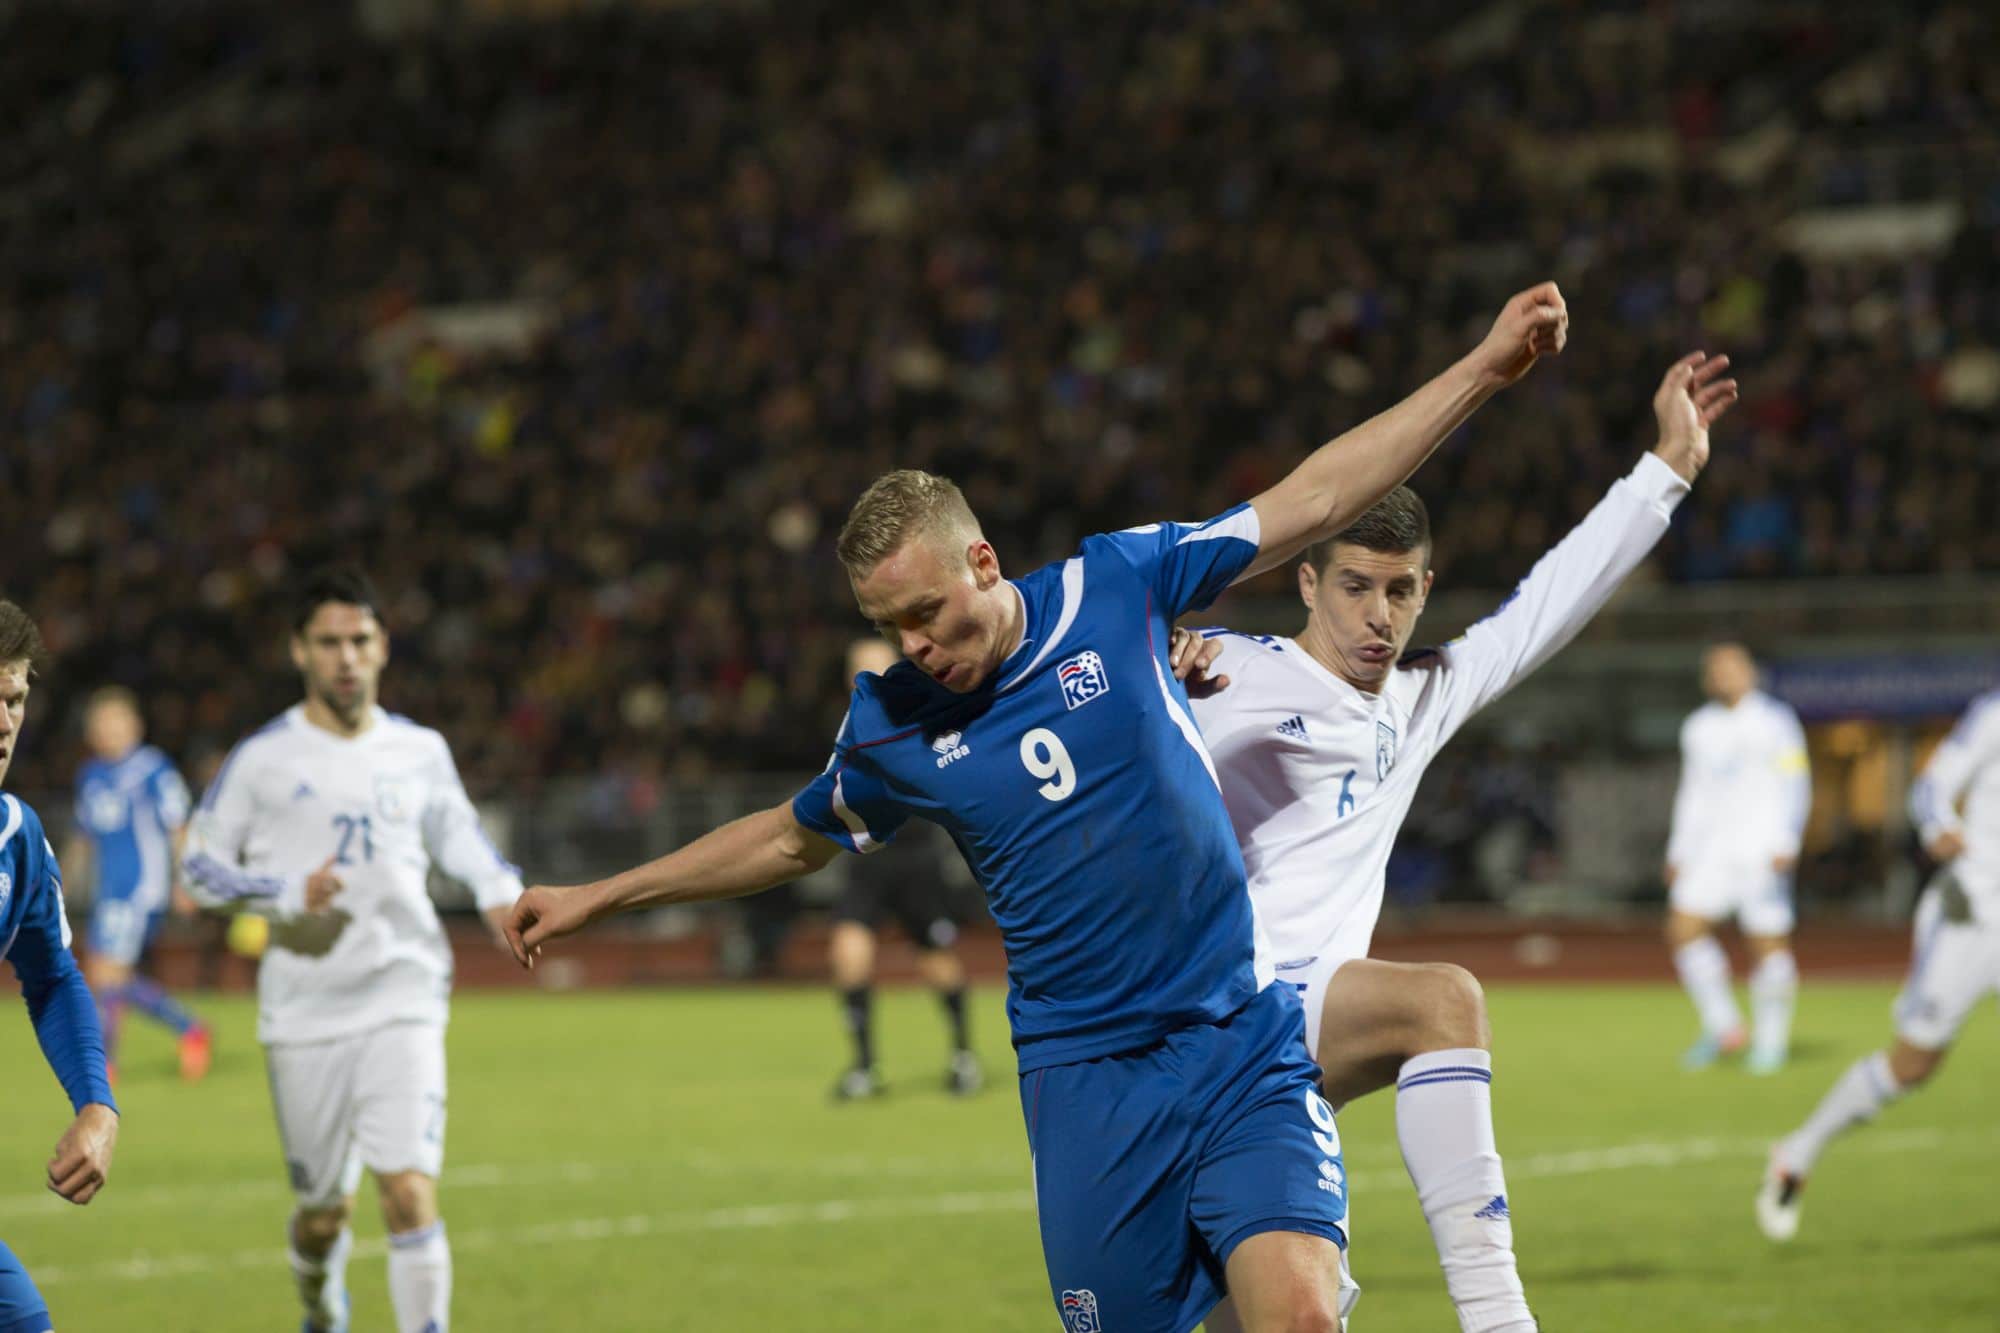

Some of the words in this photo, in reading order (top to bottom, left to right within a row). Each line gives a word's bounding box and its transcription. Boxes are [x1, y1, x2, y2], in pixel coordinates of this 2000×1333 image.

[1020, 727, 1077, 802] 9
[332, 814, 374, 864] 21
[1306, 1088, 1341, 1157] 9
